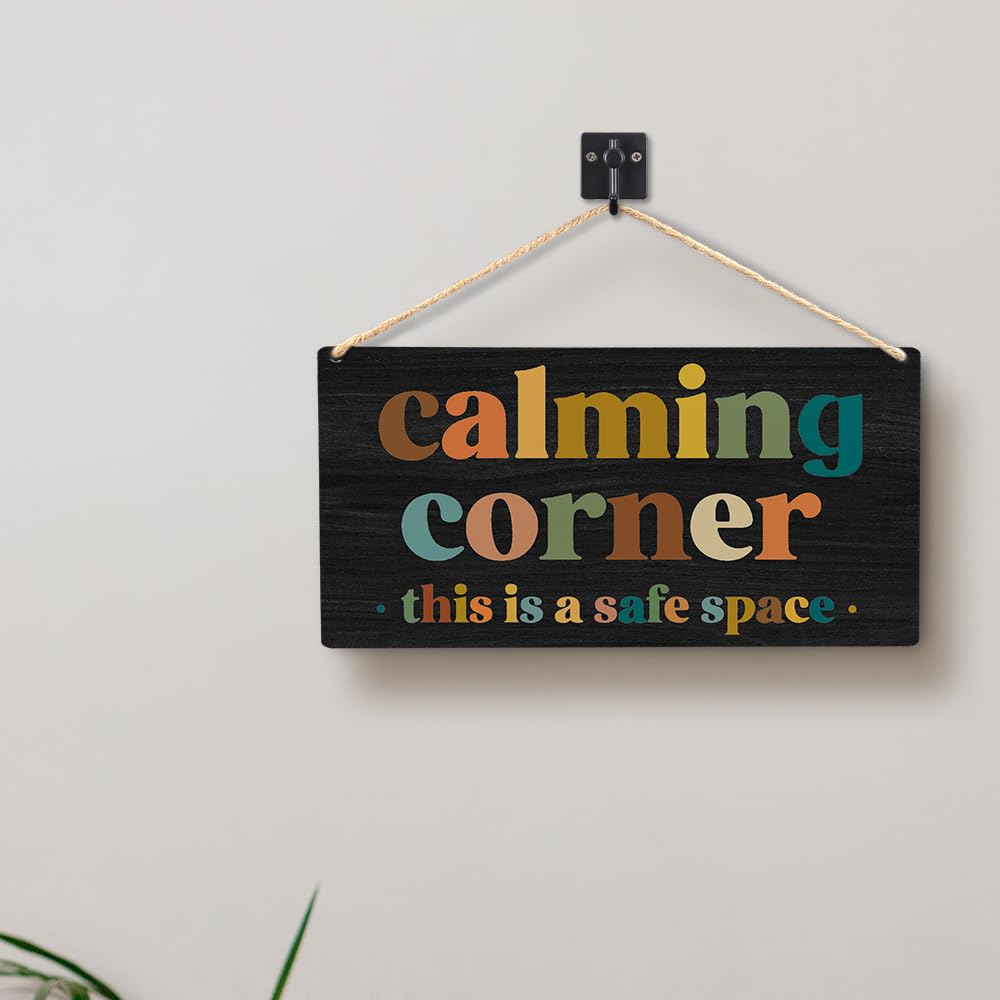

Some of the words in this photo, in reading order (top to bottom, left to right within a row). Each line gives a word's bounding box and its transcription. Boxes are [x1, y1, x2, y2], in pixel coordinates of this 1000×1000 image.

[378, 363, 863, 478] calming
[401, 492, 822, 562] corner
[401, 583, 493, 624] this
[504, 583, 544, 624] is
[554, 596, 584, 624] a
[593, 583, 690, 624] safe
[700, 596, 835, 636] space
